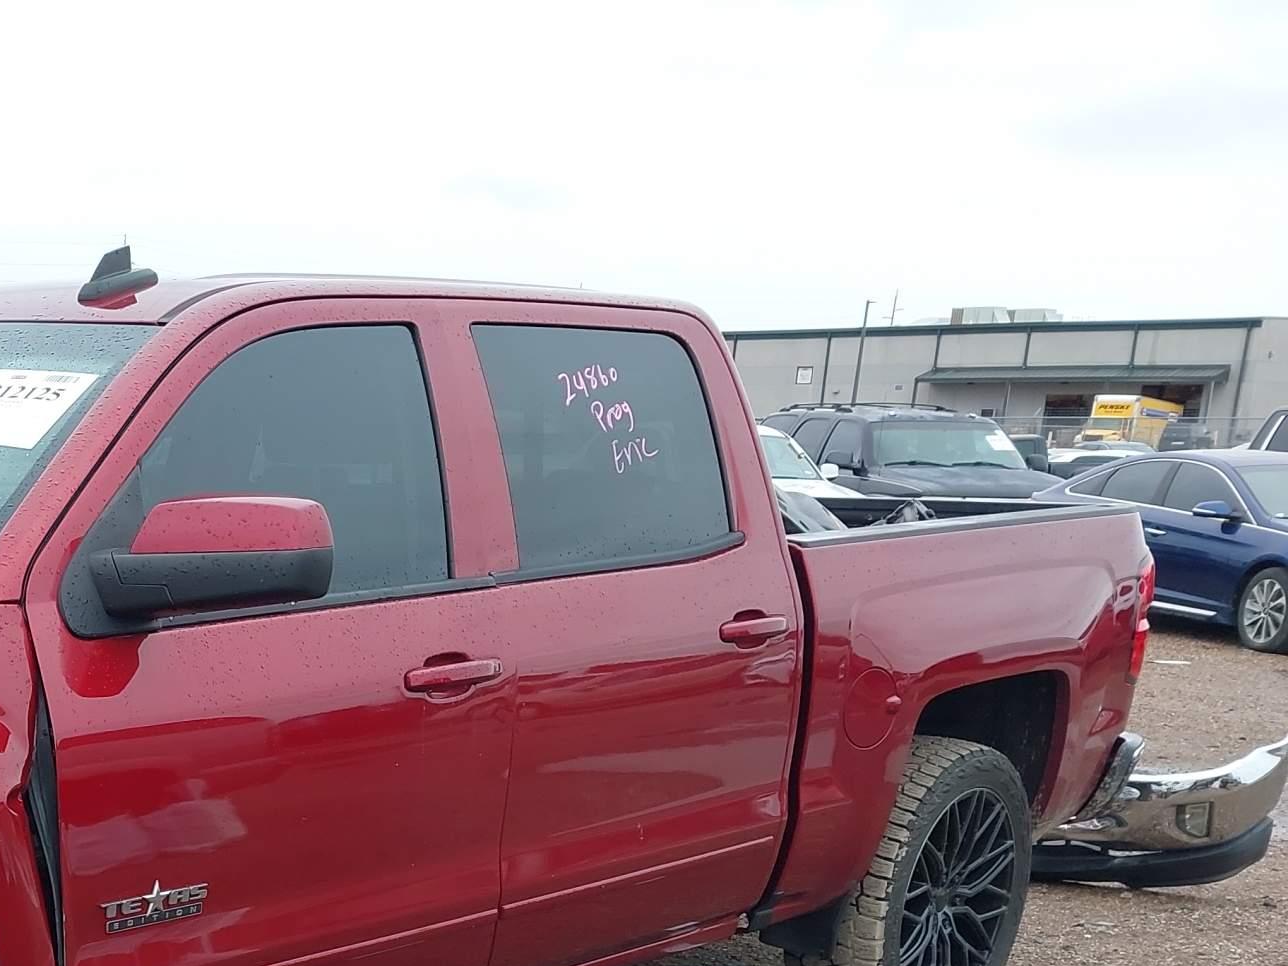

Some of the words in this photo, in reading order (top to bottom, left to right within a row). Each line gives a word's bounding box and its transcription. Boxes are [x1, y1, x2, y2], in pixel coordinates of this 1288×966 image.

[558, 364, 617, 406] 24860
[612, 437, 659, 473] Eric
[113, 905, 198, 929] EDITION
